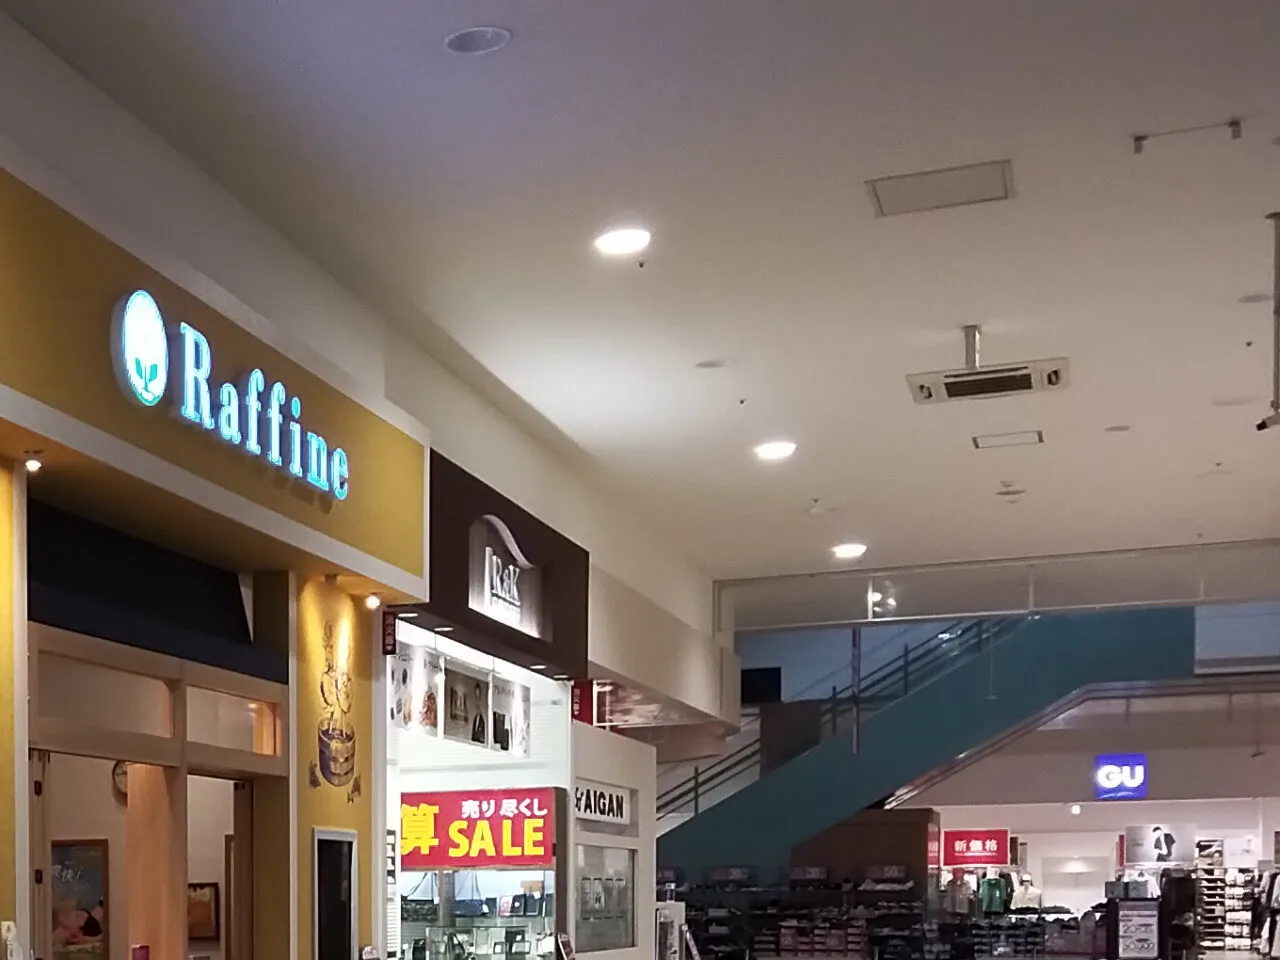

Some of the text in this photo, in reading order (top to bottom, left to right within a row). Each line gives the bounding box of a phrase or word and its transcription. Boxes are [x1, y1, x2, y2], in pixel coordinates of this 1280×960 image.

[180, 321, 349, 500] Raffine
[1097, 764, 1145, 788] GU
[462, 799, 548, 818] 売り尽くし
[448, 818, 545, 857] SALE
